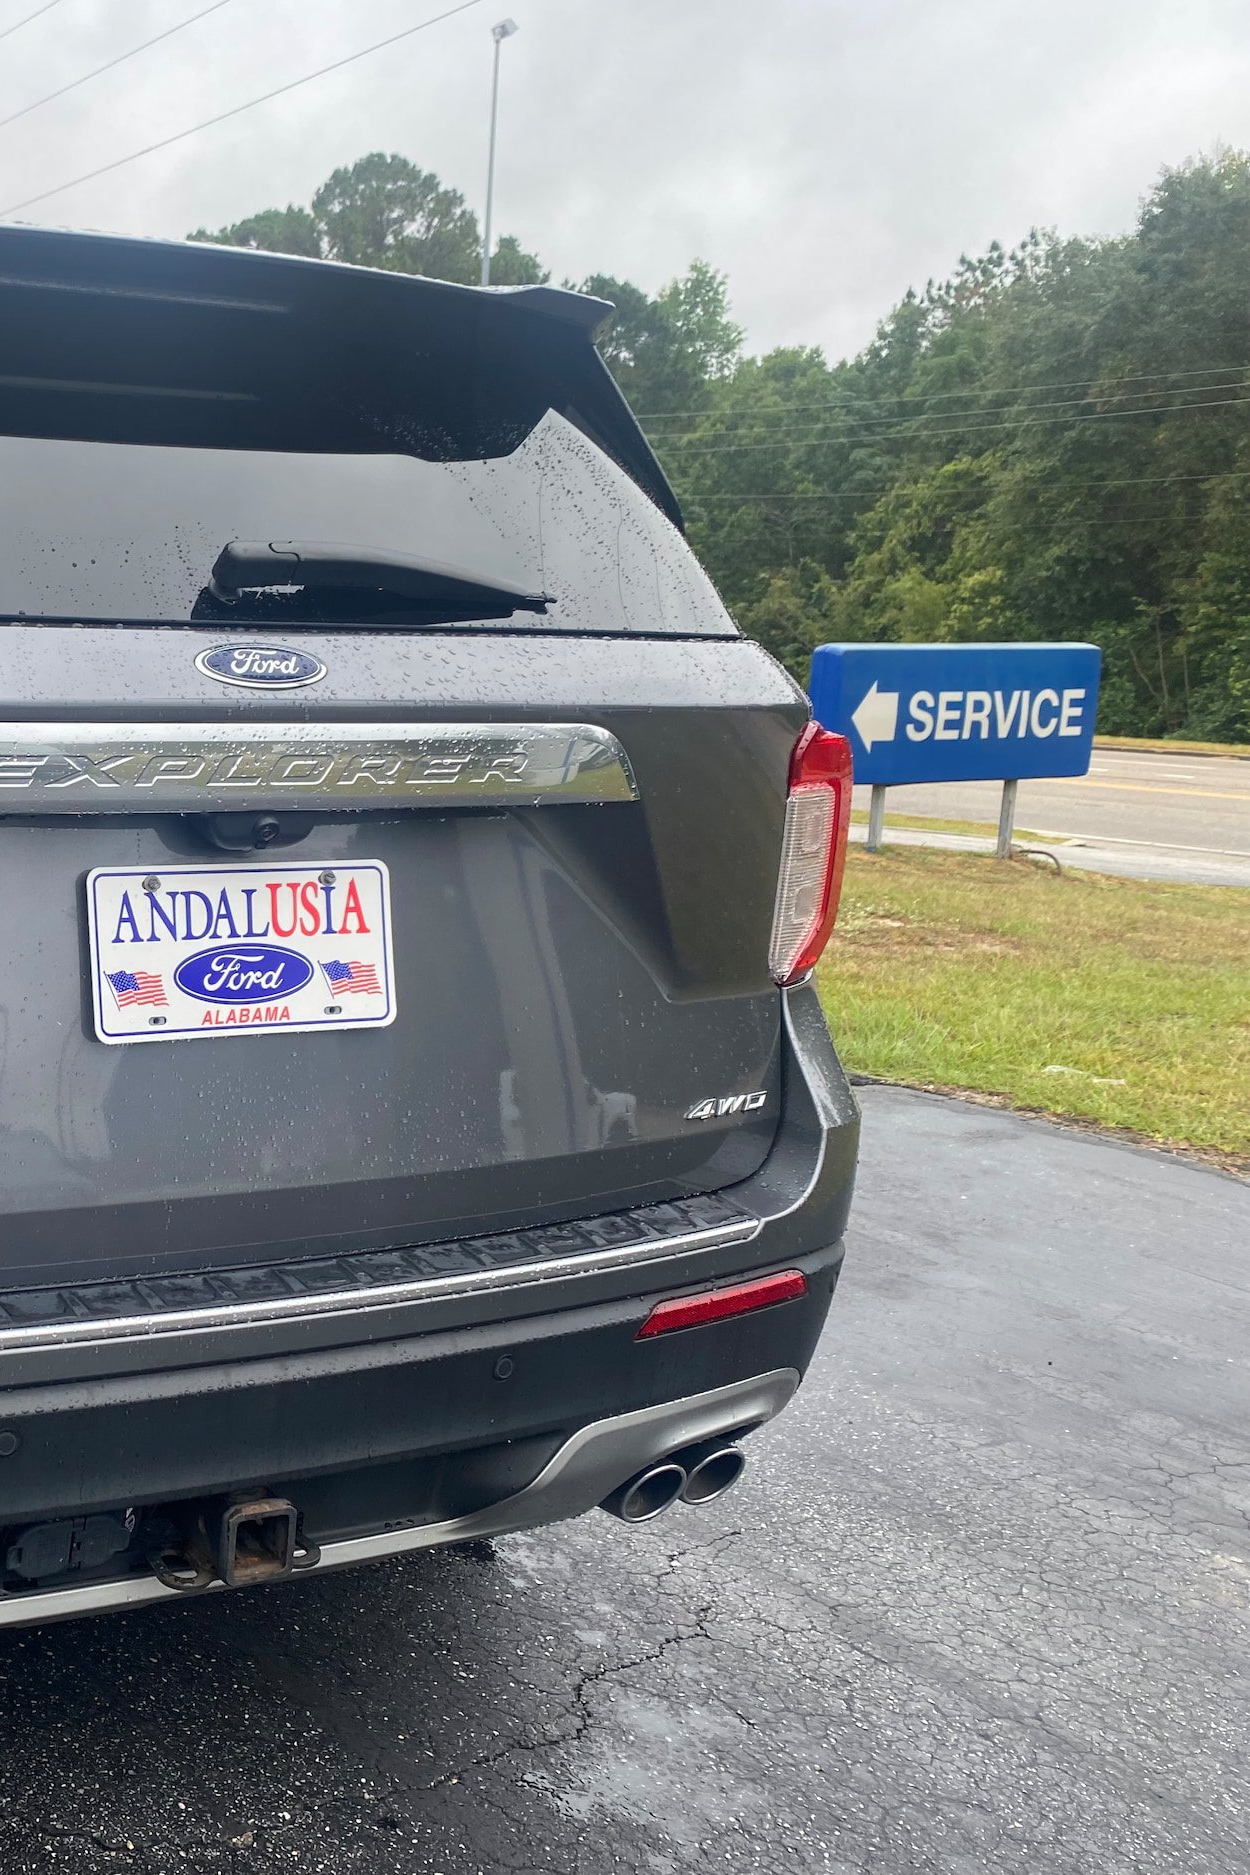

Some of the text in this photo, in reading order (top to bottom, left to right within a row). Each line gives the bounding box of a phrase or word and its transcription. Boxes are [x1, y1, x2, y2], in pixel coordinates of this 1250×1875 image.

[230, 649, 299, 674] Ford
[905, 687, 1087, 742] SERVICE
[111, 877, 370, 943] ANDALUSIA
[203, 953, 284, 992] Ford
[201, 1005, 291, 1026] ALABAMA
[683, 1090, 768, 1121] 4WD
